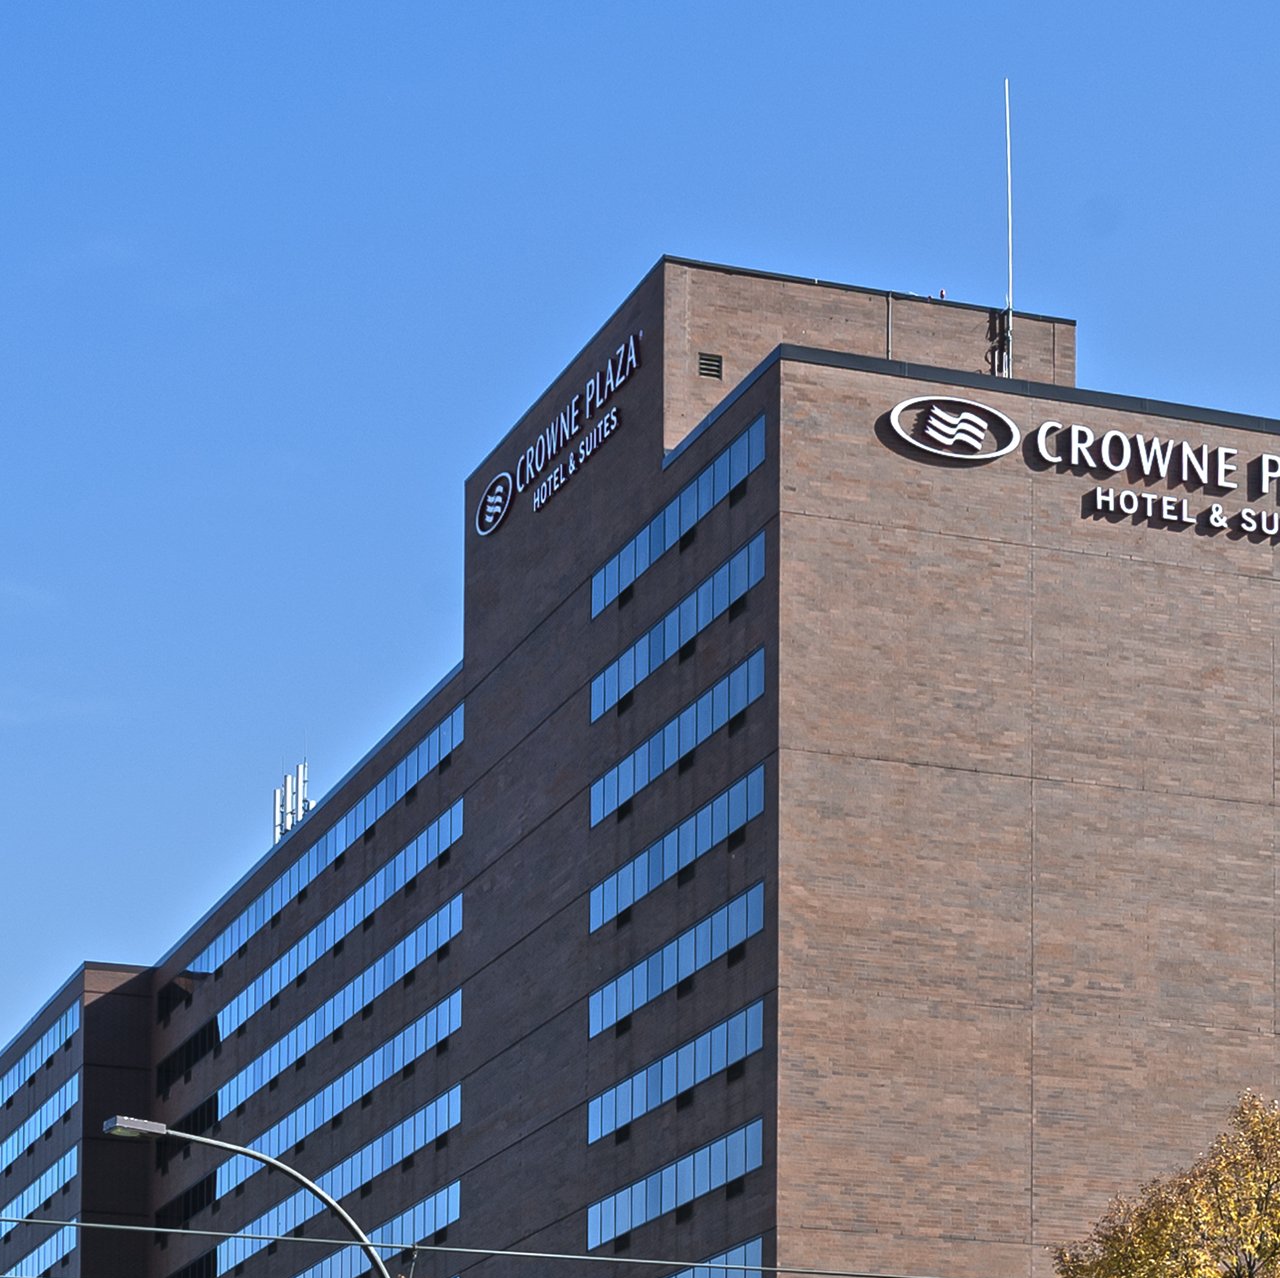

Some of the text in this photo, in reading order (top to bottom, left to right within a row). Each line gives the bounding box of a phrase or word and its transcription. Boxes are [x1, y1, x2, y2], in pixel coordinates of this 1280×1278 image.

[516, 394, 580, 493] CROWNE
[533, 407, 618, 512] HOTEL & SUITES
[1037, 420, 1239, 490] CROWNE
[1096, 486, 1197, 523] HOTEL
[1210, 503, 1228, 528] &
